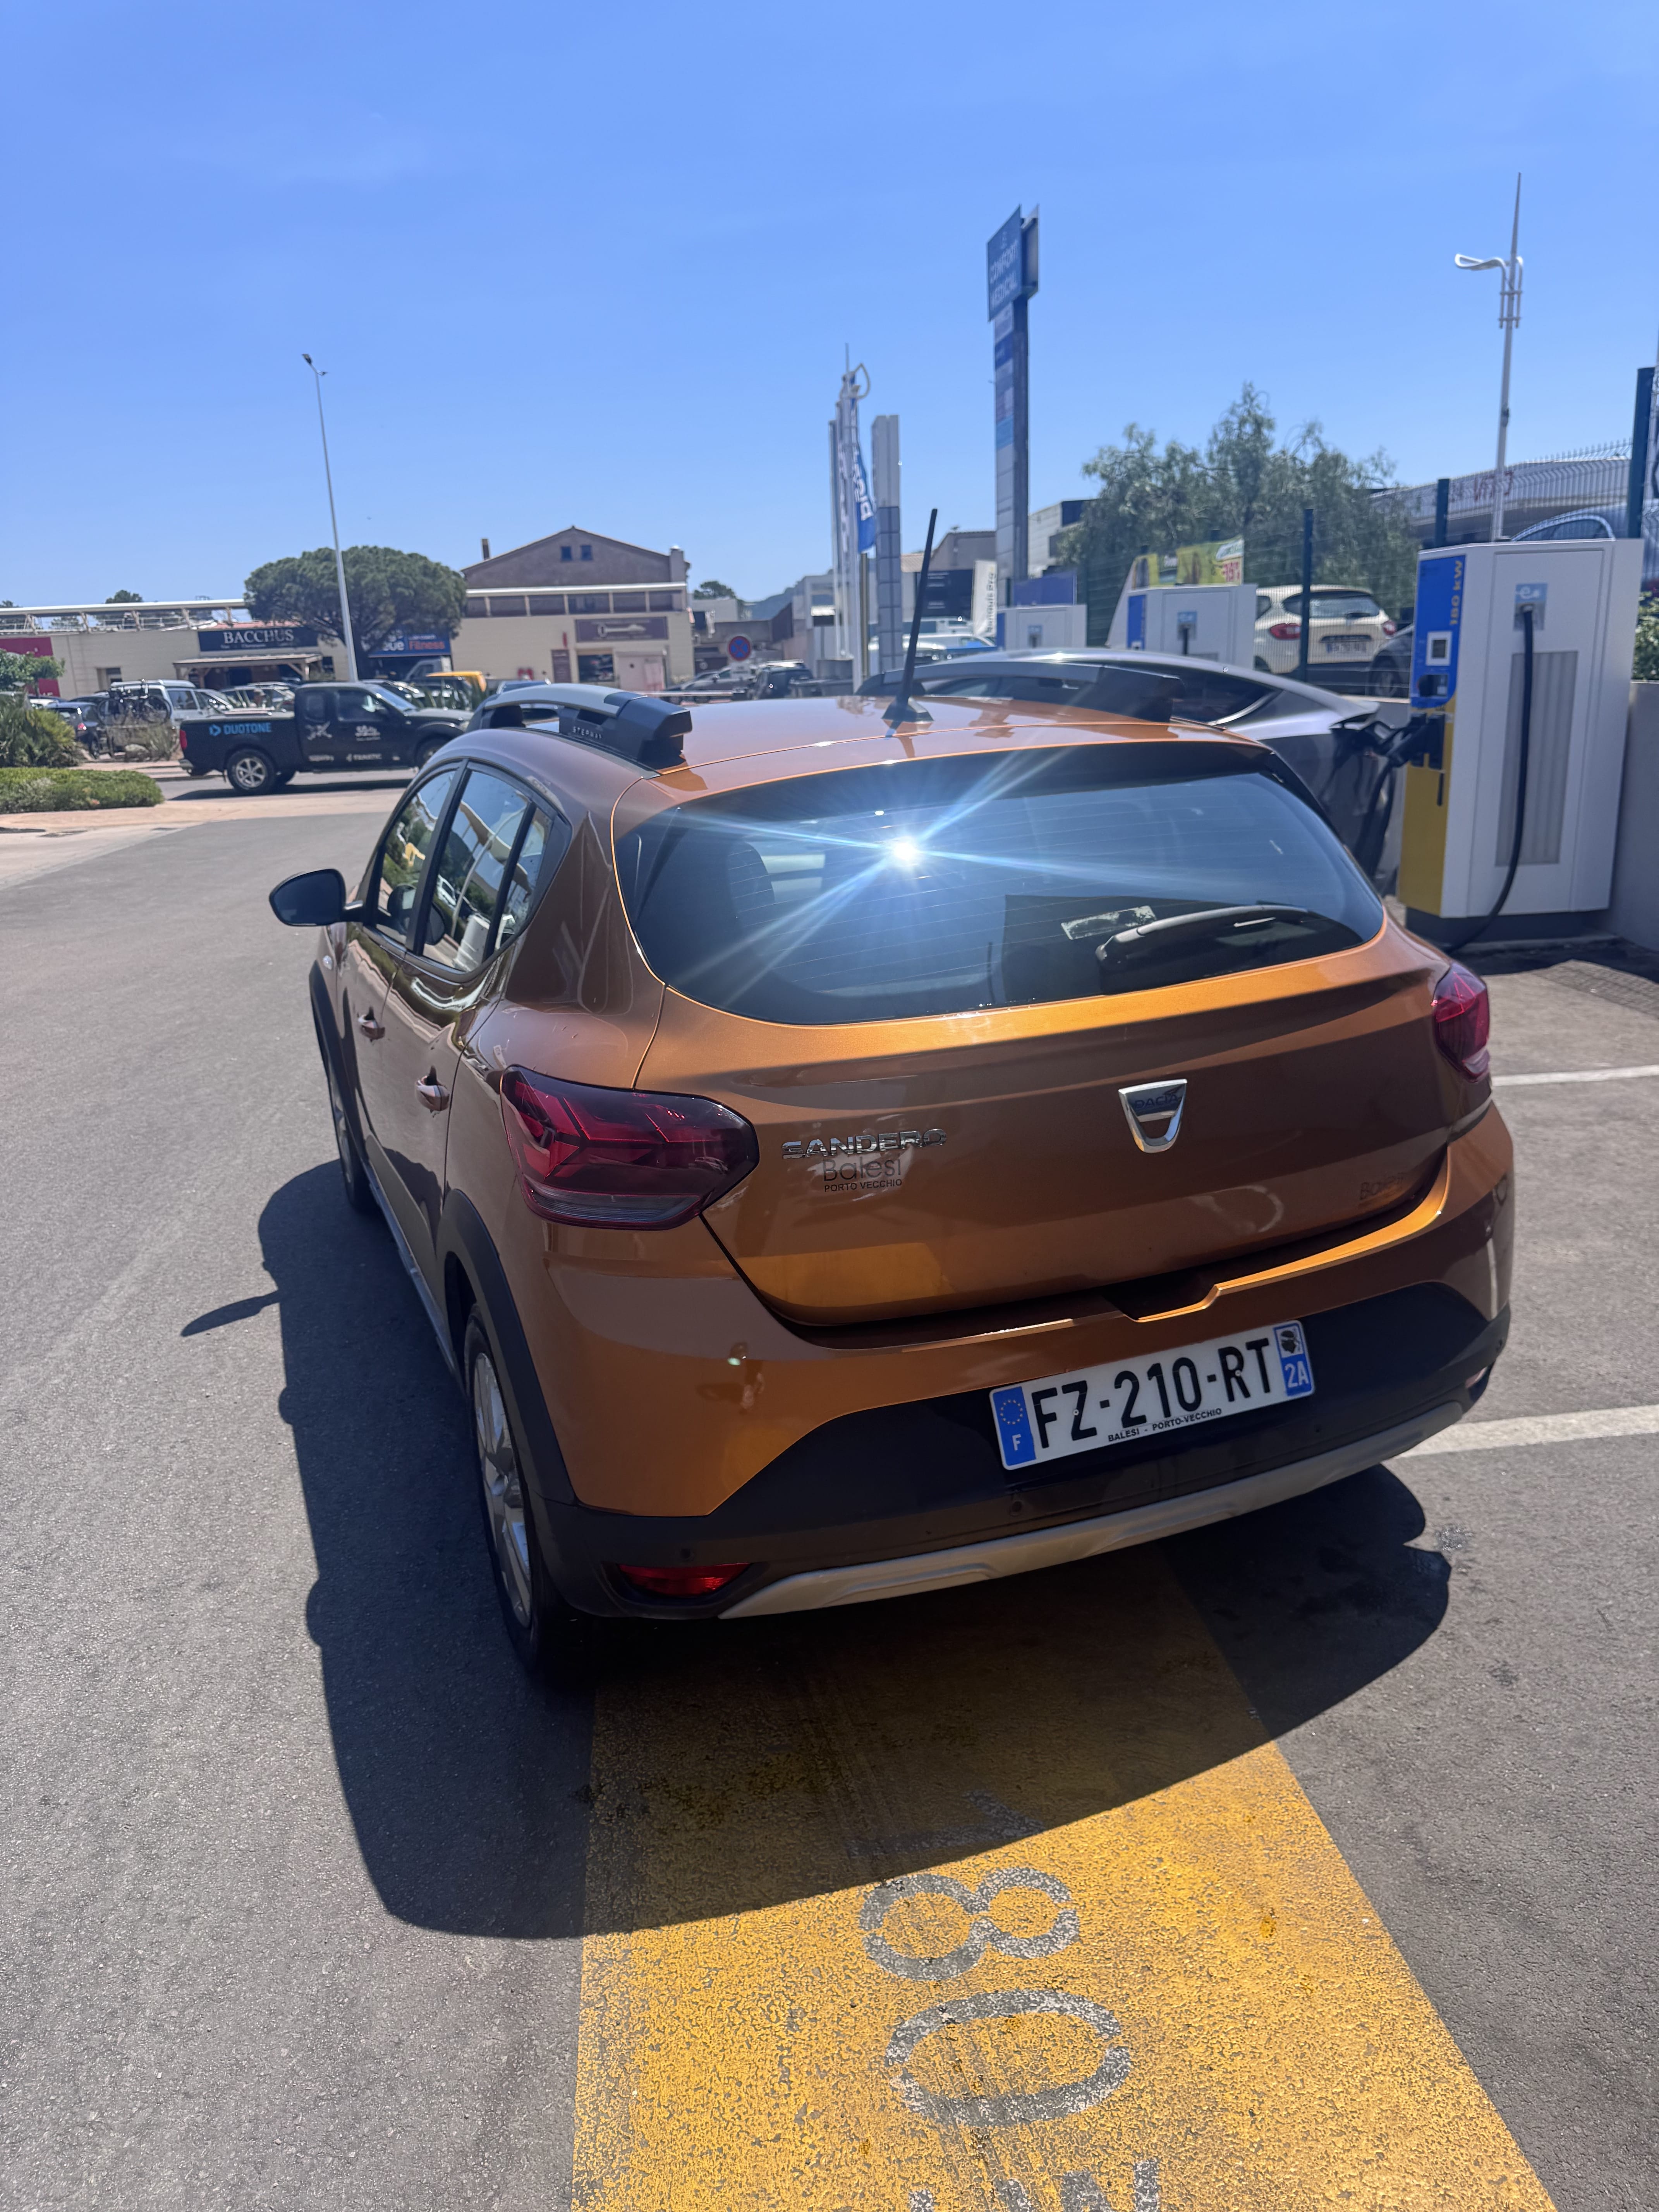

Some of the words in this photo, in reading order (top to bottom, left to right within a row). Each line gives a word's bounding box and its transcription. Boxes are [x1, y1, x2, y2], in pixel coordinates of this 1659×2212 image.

[223, 629, 294, 644] BACCHUS
[409, 641, 445, 650] Fitness
[223, 722, 271, 735] DUOTONE
[1135, 1093, 1178, 1110] DACIA
[781, 1128, 947, 1159] SANDERO
[823, 1155, 902, 1182] Balesi
[824, 1182, 857, 1192] PORTO
[859, 1178, 902, 1190] VECCHIO
[1284, 1360, 1309, 1388] 2A
[1031, 1338, 1271, 1448] FZ-210-RT
[1108, 1428, 1139, 1442] BALESI
[1152, 1408, 1221, 1431] PORTO-VECCHIO
[1012, 1434, 1022, 1451] F
